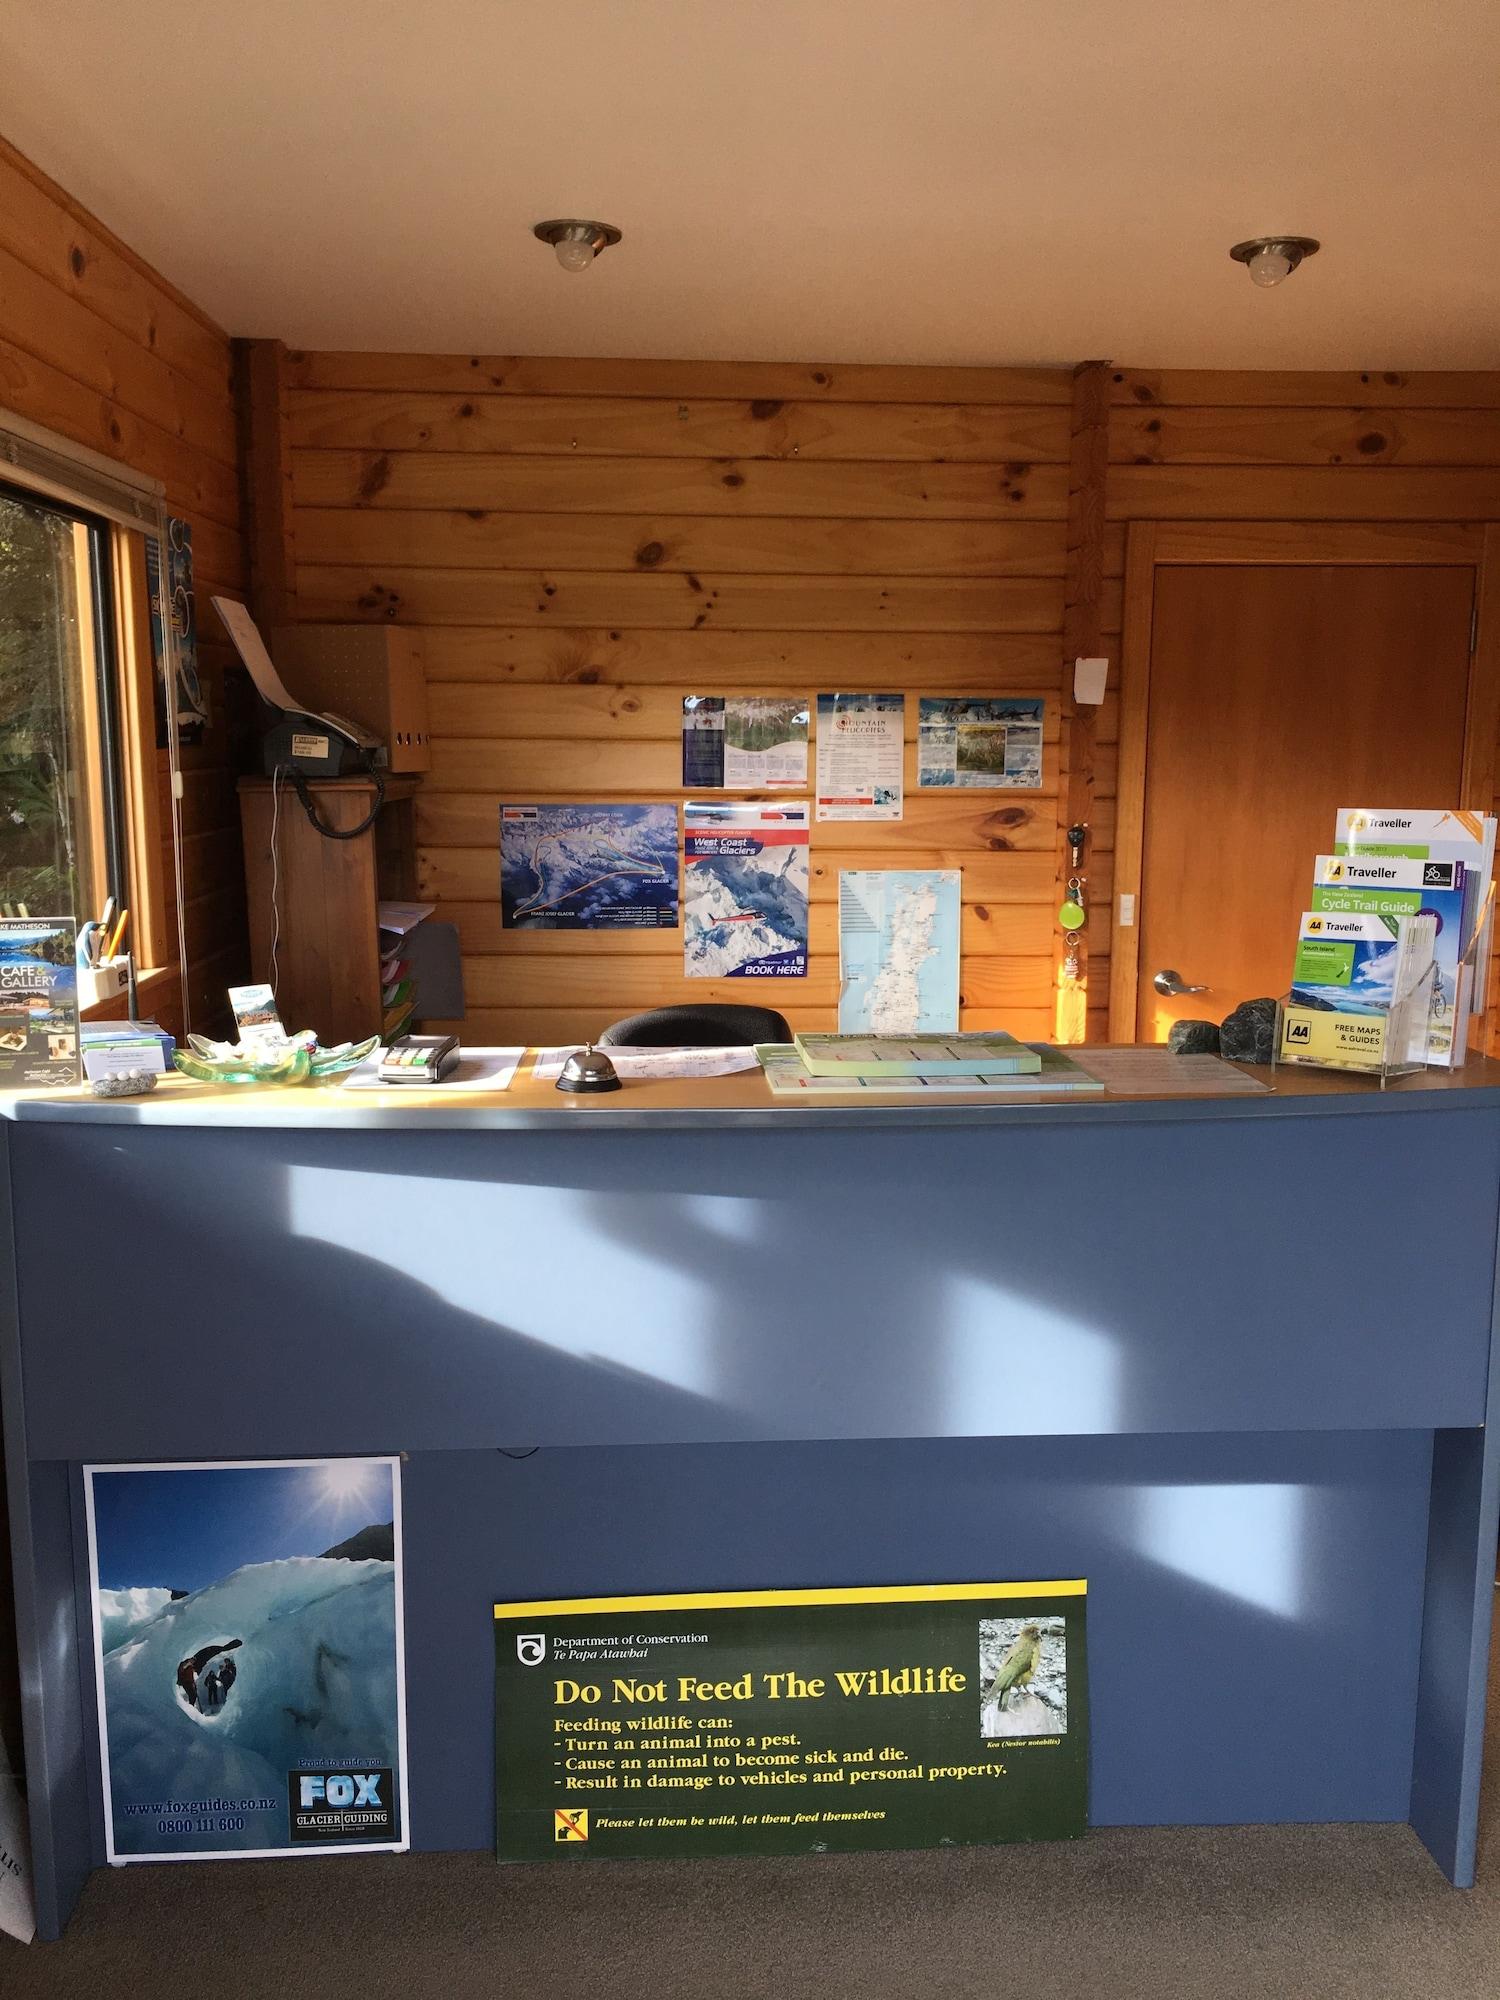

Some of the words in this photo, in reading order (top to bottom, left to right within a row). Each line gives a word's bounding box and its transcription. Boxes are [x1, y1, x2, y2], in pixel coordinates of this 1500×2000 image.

[1369, 818, 1412, 828] Traveller
[694, 838, 718, 847] West
[721, 838, 747, 847] Coast
[720, 847, 756, 855] Glaciers
[1348, 866, 1397, 878] Traveller
[1321, 899, 1350, 911] Cycle
[1353, 900, 1378, 911] Trail
[1380, 901, 1415, 913] Guide
[1310, 921, 1321, 929] AA
[1326, 922, 1363, 932] Traveller
[36, 965, 46, 976] &
[745, 965, 774, 975] BOOK
[776, 965, 805, 975] HERE
[1, 975, 58, 988] GALLERY
[1292, 1025, 1308, 1038] AA
[1334, 1024, 1355, 1033] FREE
[1357, 1026, 1381, 1035] MAPS
[1349, 1035, 1380, 1045] GUIDES
[553, 1636, 619, 1648] Department
[622, 1635, 635, 1645] of
[636, 1633, 709, 1645] Conservation
[553, 1649, 567, 1660] Te
[568, 1649, 598, 1662] Papa
[599, 1647, 649, 1659] Atawhai
[553, 1679, 602, 1705] Do
[612, 1678, 668, 1704] Not
[677, 1672, 754, 1702] Feed
[763, 1671, 825, 1699] The
[834, 1666, 967, 1697] Wildlife
[554, 1718, 622, 1735] Feeding
[626, 1715, 693, 1731] wildlife
[697, 1717, 734, 1730] can:
[565, 1737, 609, 1751] Turn
[613, 1739, 635, 1750] an
[640, 1735, 701, 1750] animal
[706, 1735, 741, 1748] into
[746, 1736, 756, 1747] a
[761, 1733, 802, 1750] pest.
[1001, 1740, 1027, 1748] (Nestor
[1028, 1738, 1061, 1746] notabilis)
[364, 1758, 381, 1768] you
[565, 1757, 616, 1771] Cause
[620, 1758, 642, 1770] an
[647, 1754, 708, 1769] animal
[712, 1755, 730, 1767] to
[735, 1752, 800, 1767] become
[804, 1749, 838, 1764] sick
[842, 1748, 874, 1763] and
[878, 1747, 909, 1761] die.
[565, 1774, 618, 1789] Result
[623, 1775, 642, 1788] in
[646, 1774, 713, 1790] damage
[718, 1774, 736, 1786] to
[740, 1770, 807, 1785] vehicles
[812, 1768, 845, 1783] and
[849, 1764, 923, 1785] personal
[928, 1763, 1007, 1782] property.
[300, 1774, 382, 1809] FOX
[124, 1798, 278, 1815] www.foxguides.co.nz
[157, 1819, 193, 1834] 0800
[196, 1818, 214, 1832] 111
[218, 1817, 245, 1831] 600
[296, 1815, 341, 1825] GLACIER
[344, 1813, 388, 1823] GUIDING
[595, 1818, 635, 1828] Please
[638, 1817, 653, 1826] let
[657, 1817, 687, 1827] them
[690, 1816, 705, 1826] be
[708, 1815, 739, 1826] wild,
[742, 1815, 757, 1825] let
[761, 1814, 791, 1824] them
[791, 1812, 819, 1825] feed
[822, 1810, 886, 1822] themselves
[0, 1849, 22, 1876] LIS
